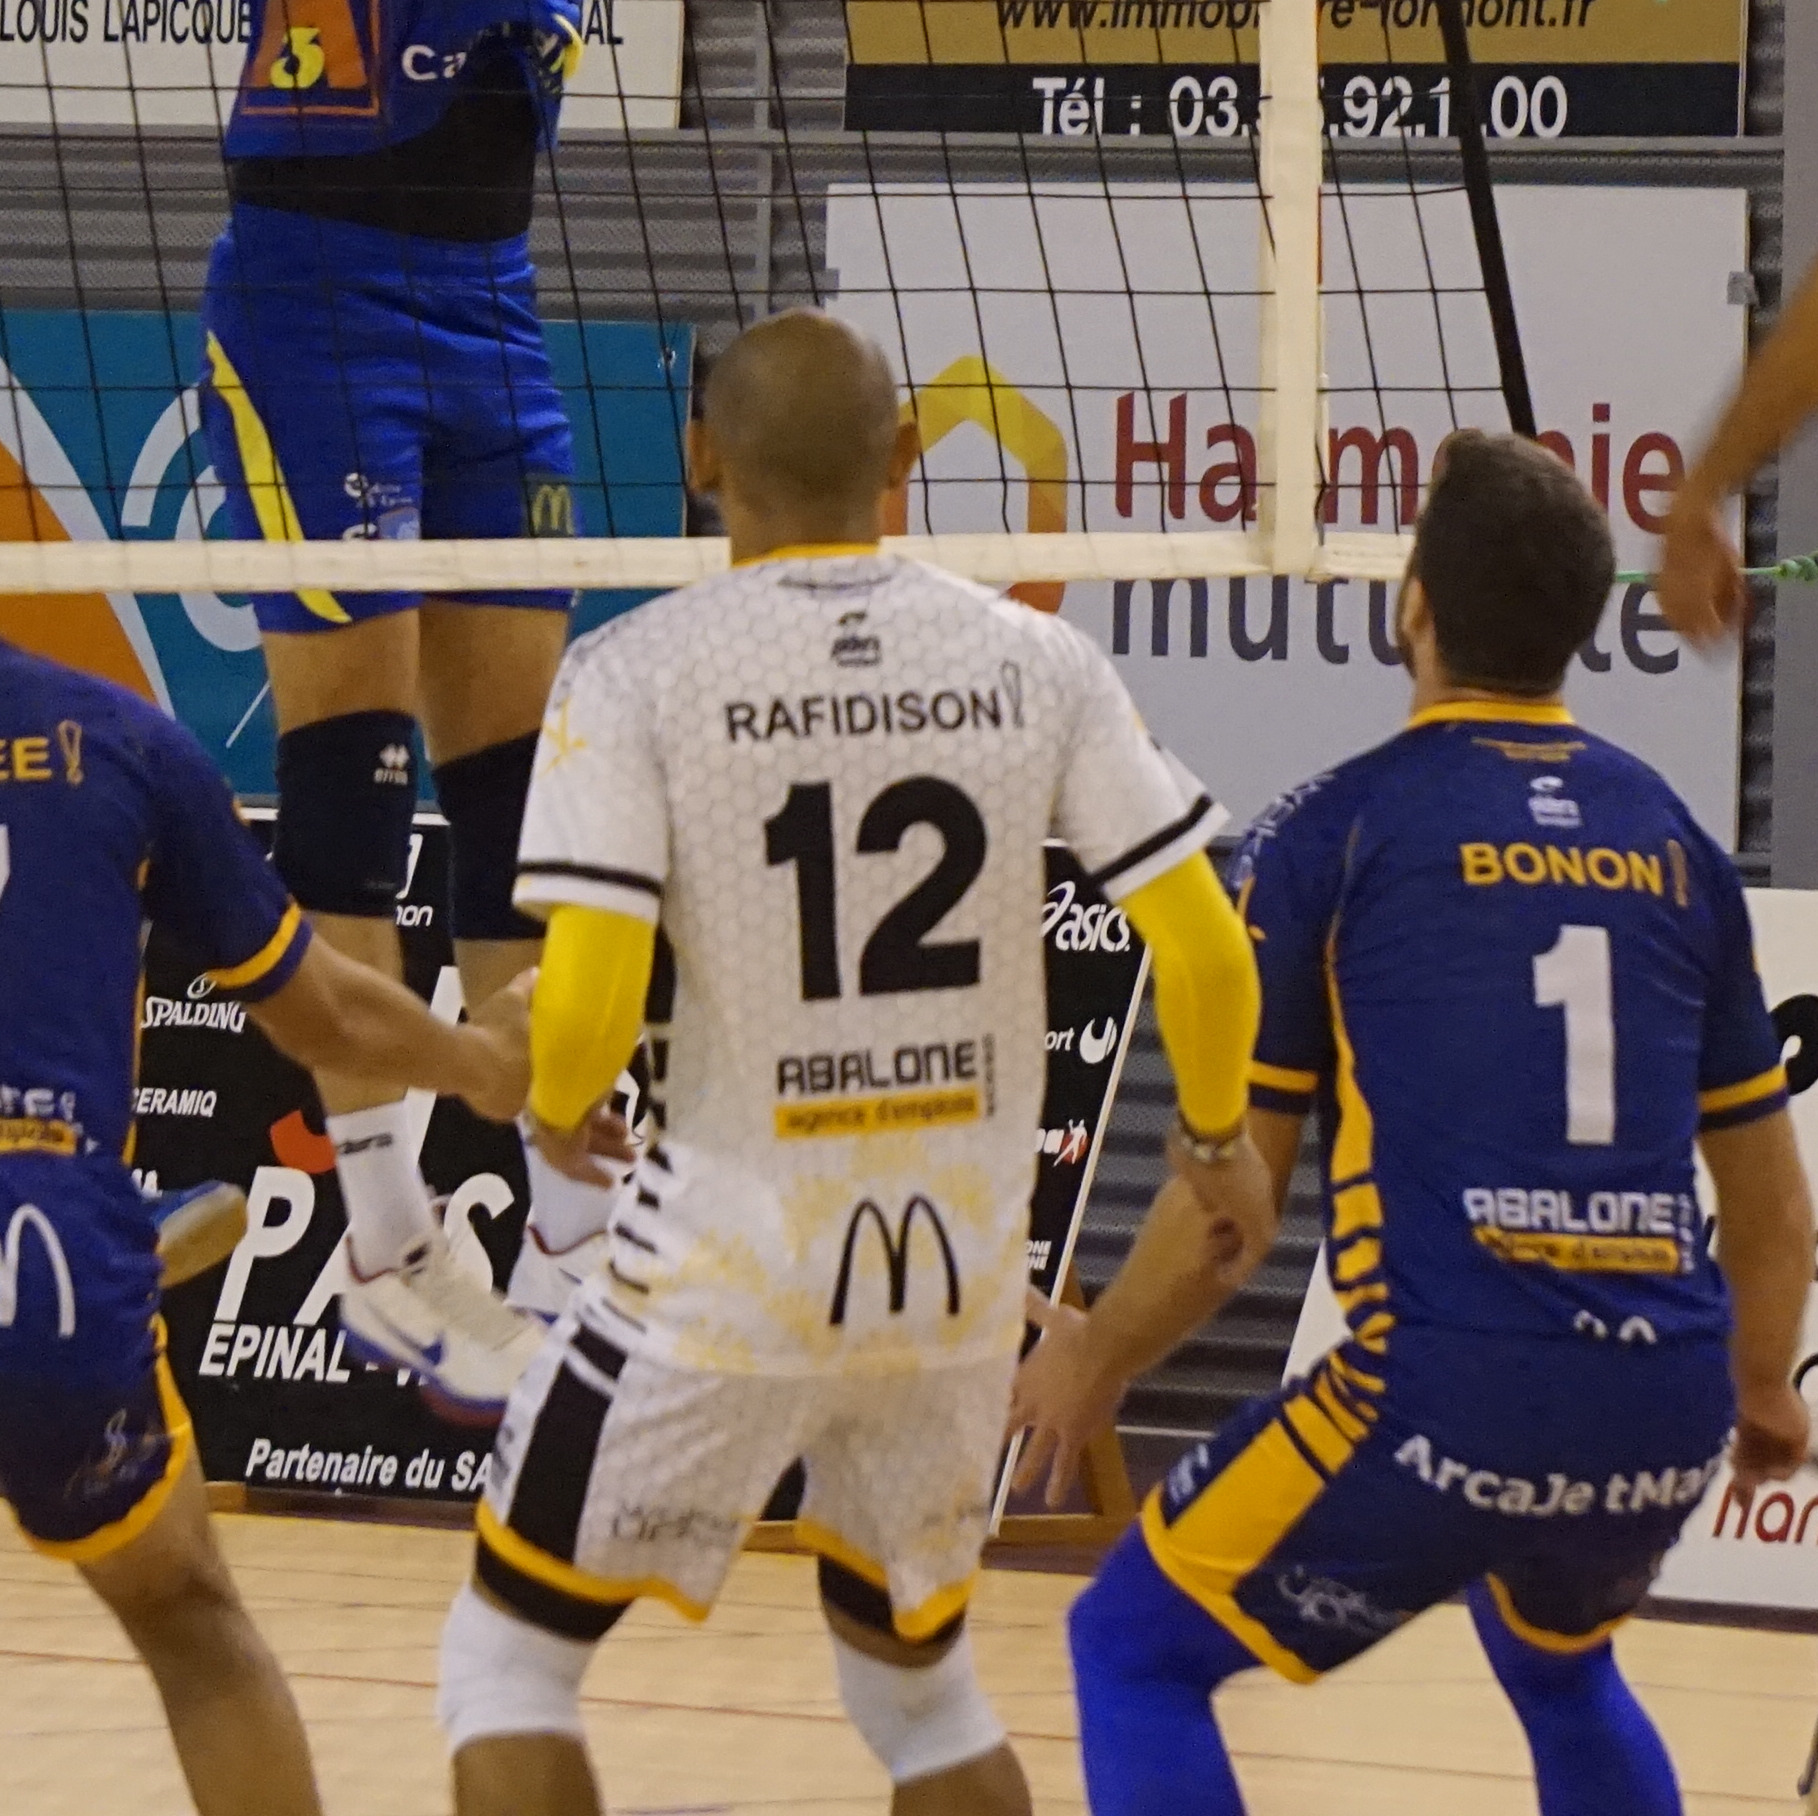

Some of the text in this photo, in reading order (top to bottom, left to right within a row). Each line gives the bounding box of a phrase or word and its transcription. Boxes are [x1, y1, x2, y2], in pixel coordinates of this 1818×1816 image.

[1113, 392, 1686, 536] Hamie
[724, 694, 1003, 743] RAFIDISON
[764, 776, 986, 1001] 12
[1462, 840, 1664, 897] BONON
[142, 996, 246, 1034] SPALDING
[1533, 924, 1616, 1145] 1
[778, 1039, 978, 1095] ABALONE
[1463, 1187, 1676, 1235] ABALONE
[199, 1322, 351, 1384] EPINAL
[246, 1437, 398, 1486] Partenaire
[405, 1448, 446, 1487] du
